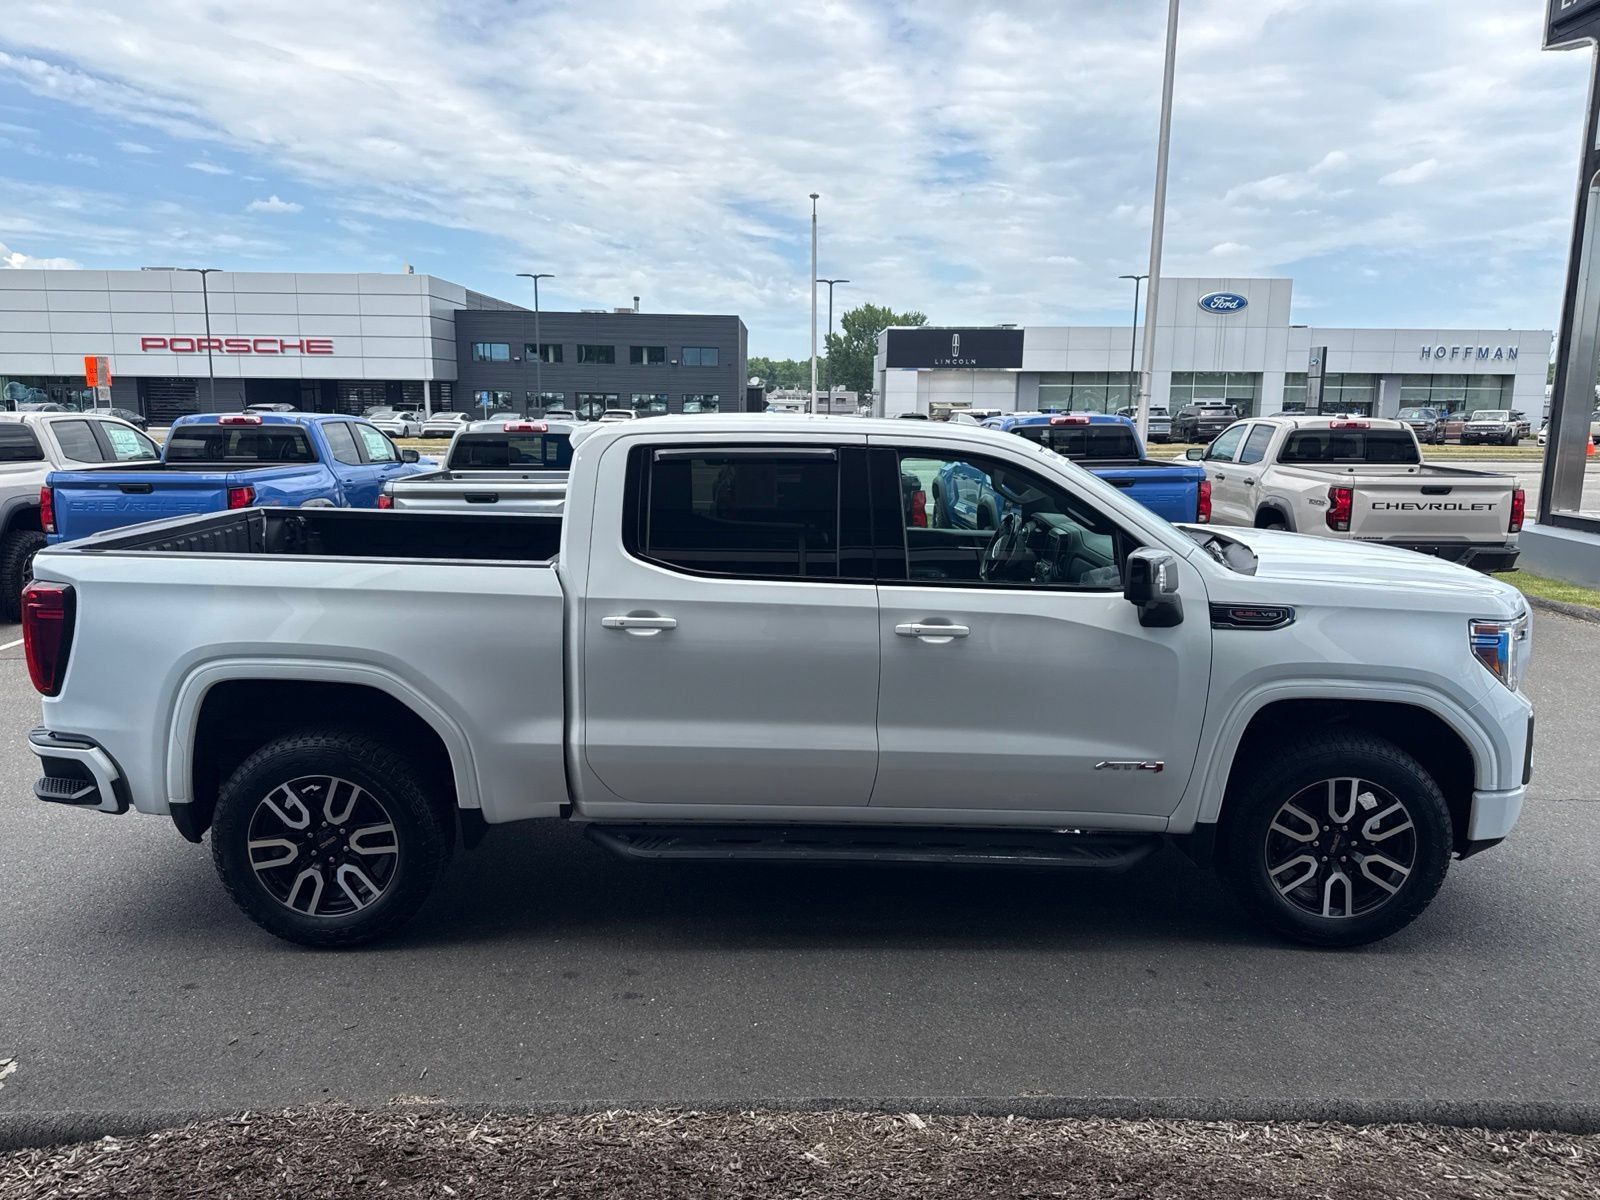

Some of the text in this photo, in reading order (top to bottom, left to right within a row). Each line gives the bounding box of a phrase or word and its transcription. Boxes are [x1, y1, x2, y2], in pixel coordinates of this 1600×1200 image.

[1210, 296, 1240, 309] Ford
[140, 337, 334, 354] PORSCHE
[1421, 346, 1519, 359] HOFFMAN
[70, 502, 208, 512] CHEVROLET
[1371, 502, 1498, 511] CHEVROLET
